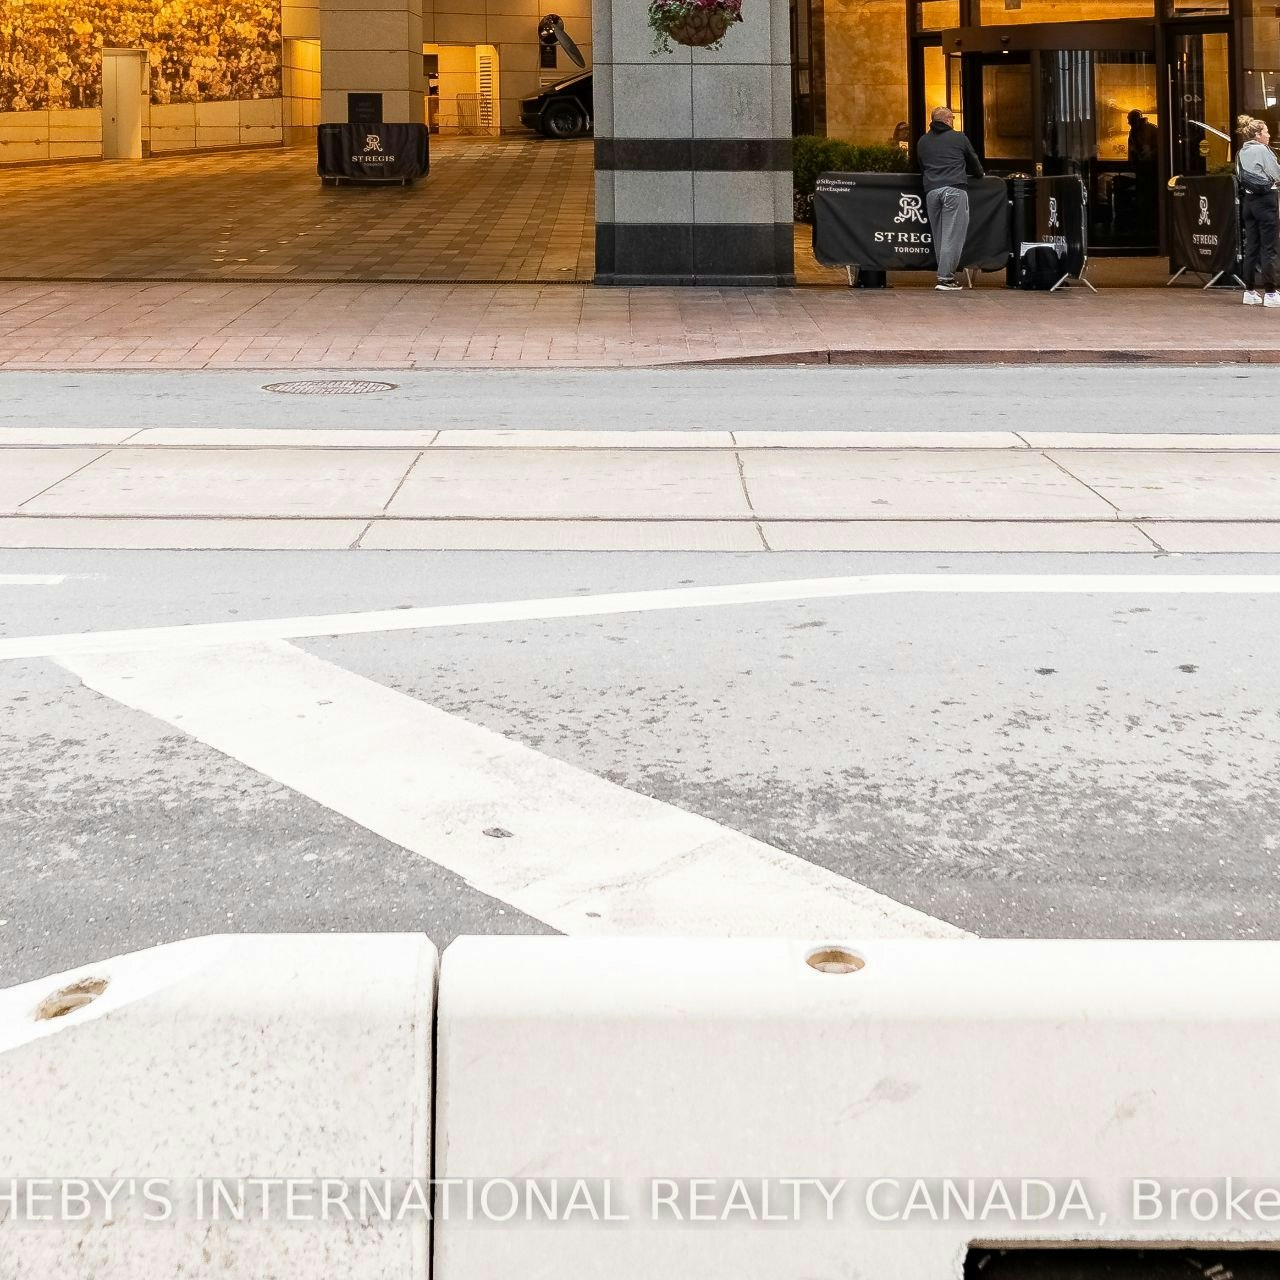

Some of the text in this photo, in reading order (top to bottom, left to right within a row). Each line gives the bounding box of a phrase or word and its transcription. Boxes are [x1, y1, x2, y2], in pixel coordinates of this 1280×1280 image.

[897, 231, 931, 243] REG
[1200, 234, 1218, 246] REGIS
[894, 246, 930, 254] TORONTO
